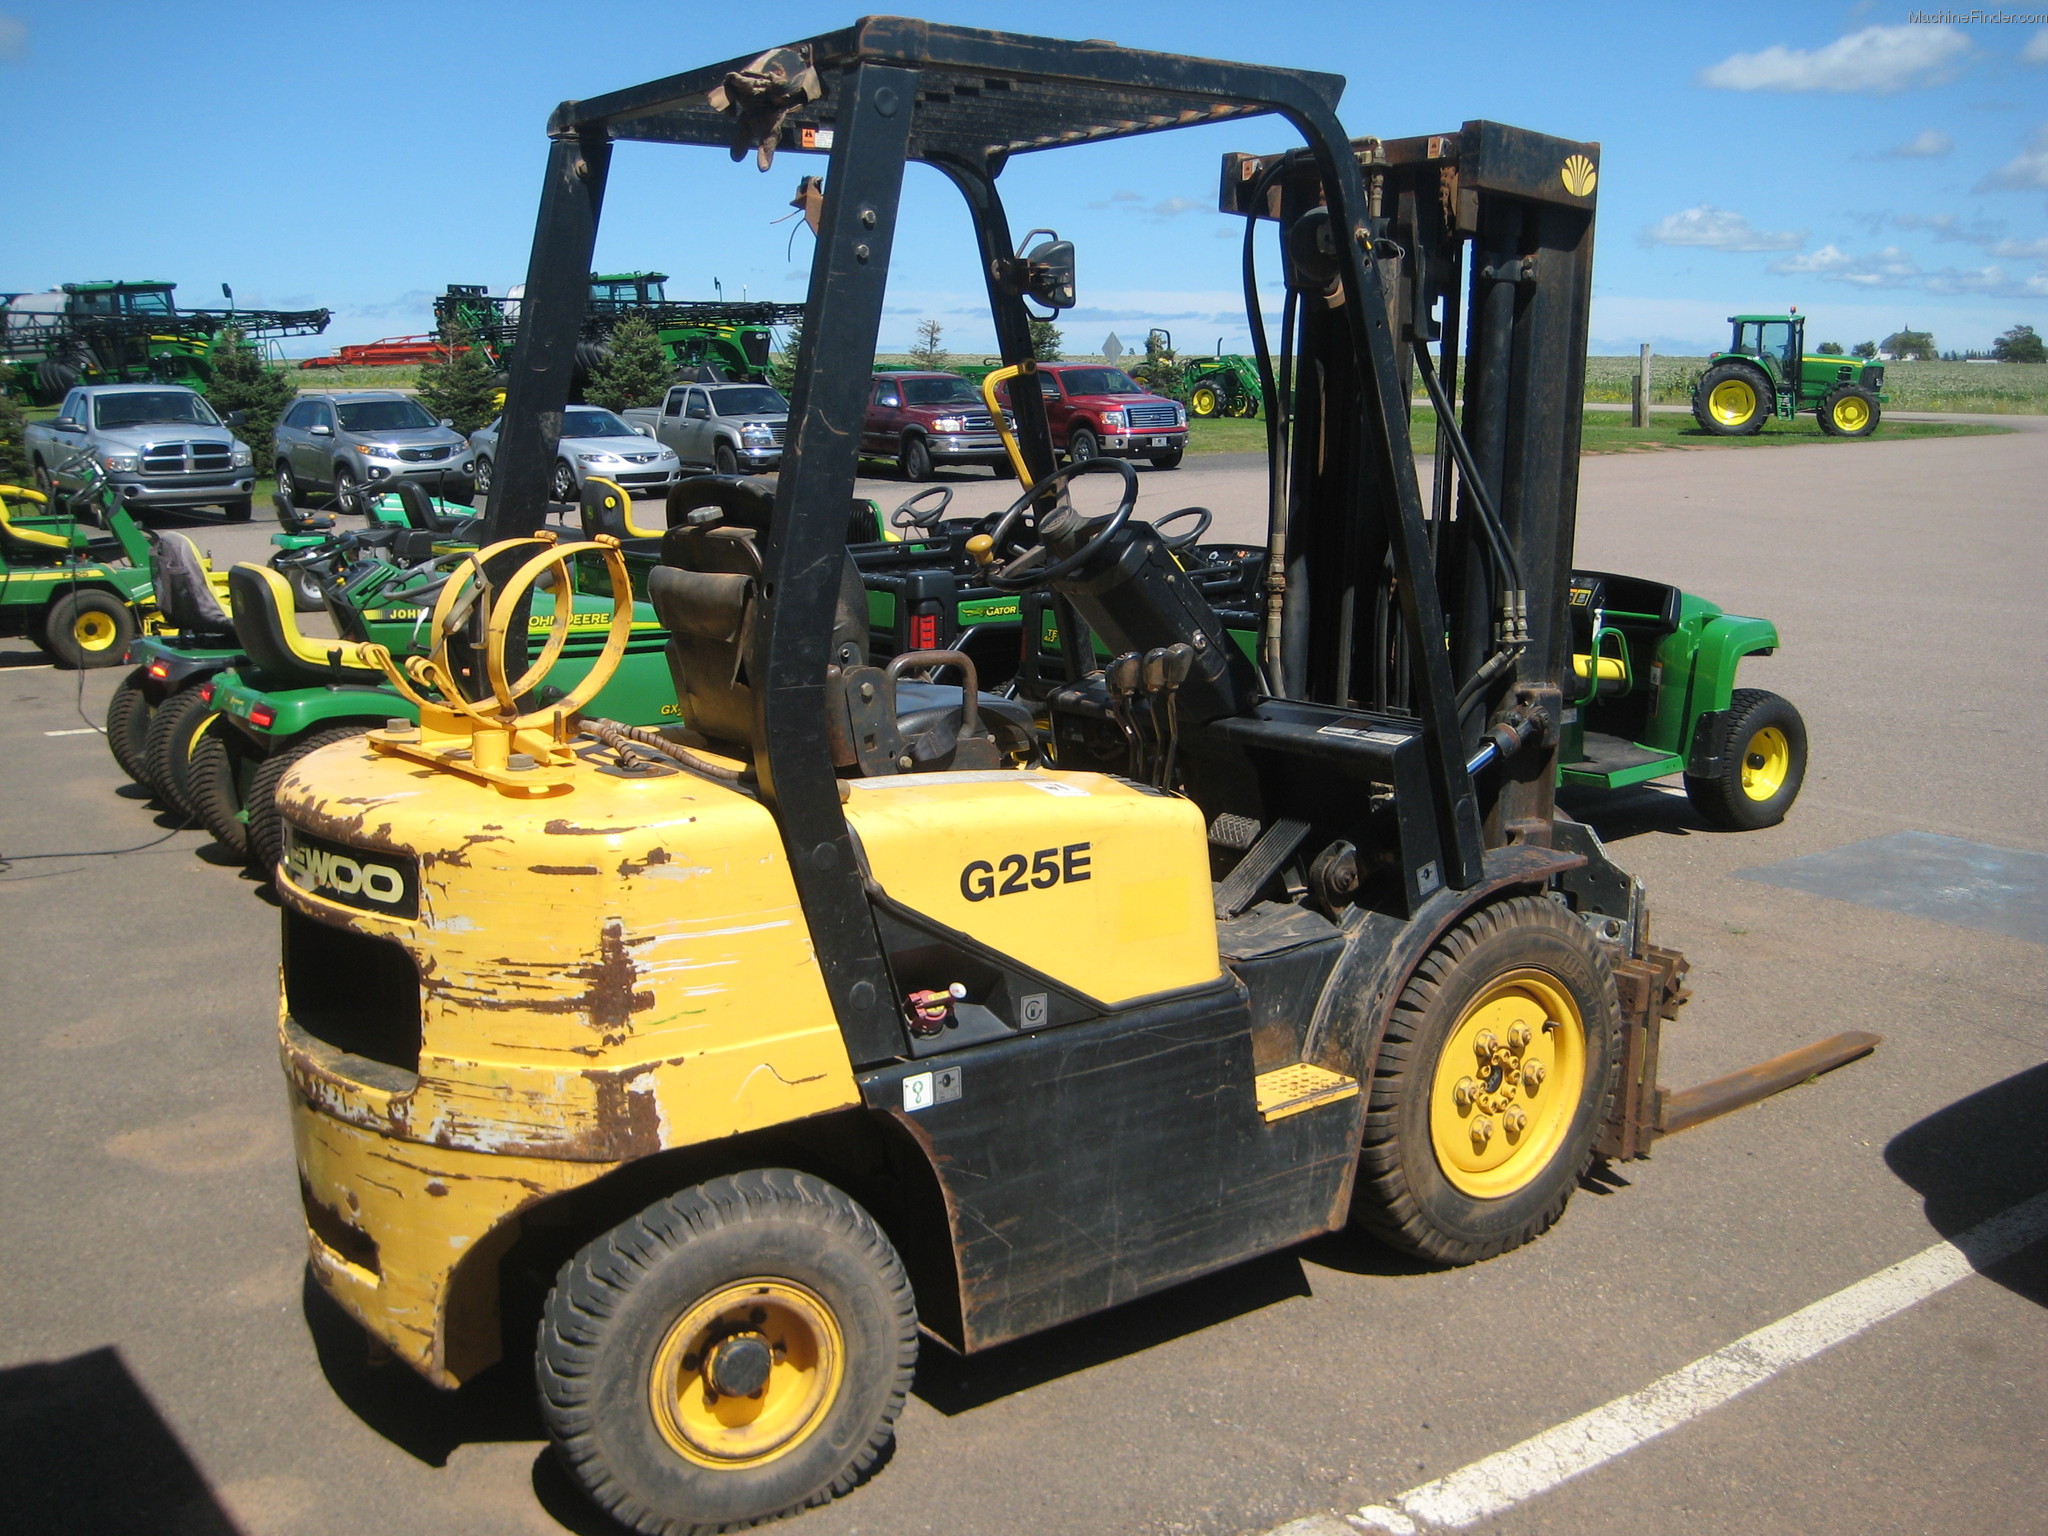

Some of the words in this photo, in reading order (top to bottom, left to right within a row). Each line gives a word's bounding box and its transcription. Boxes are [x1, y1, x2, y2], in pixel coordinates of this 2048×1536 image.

[528, 615, 555, 626] OH
[986, 606, 1017, 616] GATOR
[285, 846, 405, 904] EWOO
[960, 841, 1092, 902] G25E
